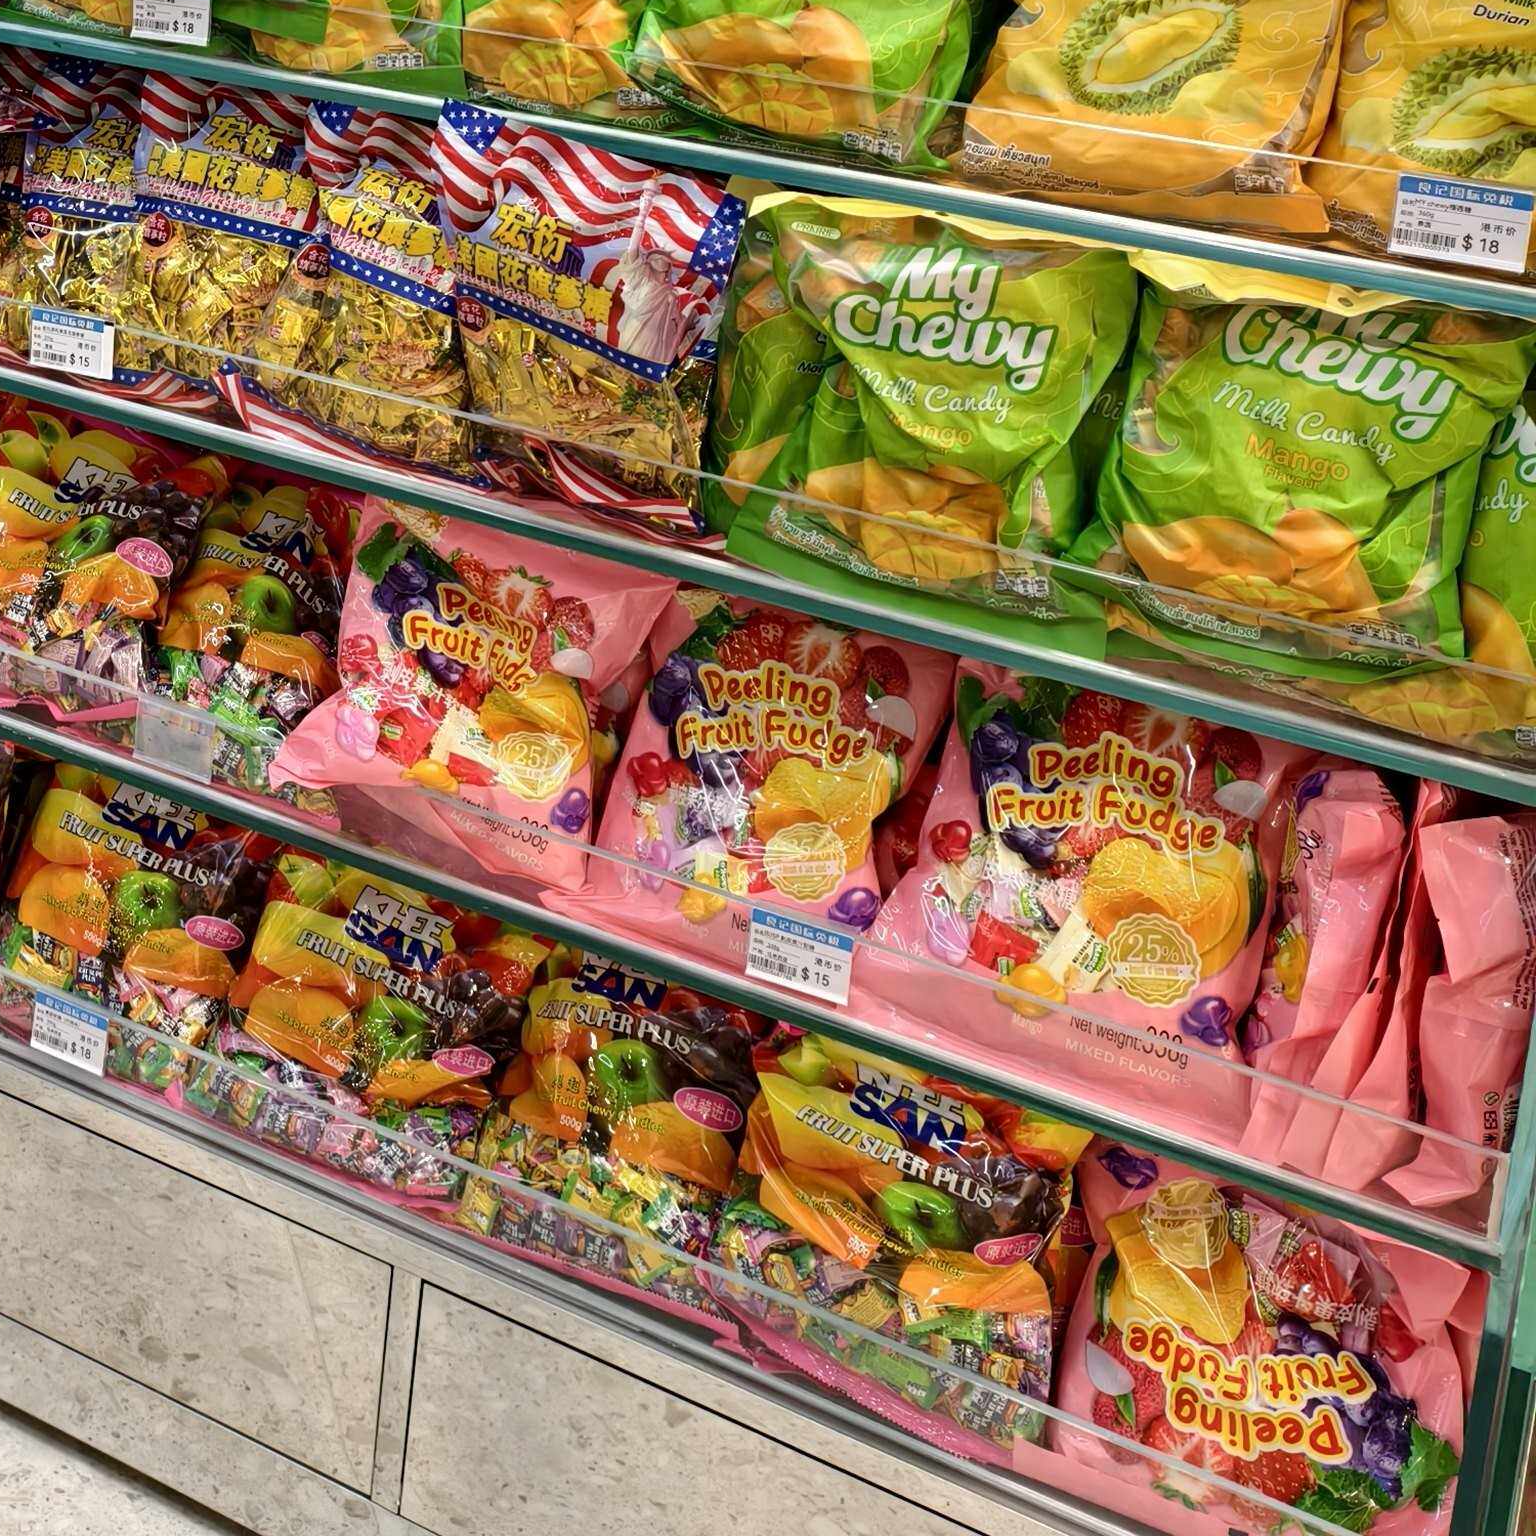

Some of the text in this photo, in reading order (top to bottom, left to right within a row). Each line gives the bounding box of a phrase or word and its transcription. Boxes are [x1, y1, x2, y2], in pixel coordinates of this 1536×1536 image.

[172, 20, 194, 33] $ 18
[1473, 4, 1531, 27] Durian
[491, 202, 574, 263] 宏衍
[1462, 234, 1473, 252] $
[1479, 238, 1500, 254] 18
[892, 246, 1001, 321] My
[69, 354, 89, 367] $ 15
[834, 294, 1057, 392] Chewy
[1224, 306, 1461, 441] Chewy
[923, 384, 1014, 423] Candy
[1214, 378, 1397, 465] Milk Candy
[1244, 433, 1351, 484] Mango
[1263, 465, 1322, 489] Flavour
[8, 488, 145, 522] FRUIT PLUS
[283, 573, 327, 615] PLUS
[408, 613, 486, 664] Fruit
[703, 663, 833, 713] Peeling
[679, 709, 867, 765] Fruit Fudge
[1035, 737, 1178, 797] Peeling
[102, 800, 197, 850] SAN
[992, 785, 1217, 850] Fruit Fudge
[59, 811, 210, 887] FRUIT SUPER PLUS
[353, 884, 455, 946] KHEE
[297, 929, 456, 1018] FRUIT SUPER PLUS
[1126, 932, 1181, 965] 25%
[572, 963, 667, 1011] SAN
[801, 966, 830, 987] $ 15
[71, 1042, 91, 1059] $ 18
[537, 999, 692, 1055] FRUIT SUPER PLUS
[1065, 1038, 1192, 1088] MIXED FLAVORS
[558, 1115, 583, 1132] 500g
[586, 1099, 617, 1121] Chewy
[682, 1094, 739, 1127] 原装进口
[849, 1084, 965, 1155] SAN
[796, 1104, 994, 1209] FRUIT SUPER PLUS
[1126, 1325, 1368, 1405] Fruit Fudge
[1173, 1392, 1344, 1457] Peeling
